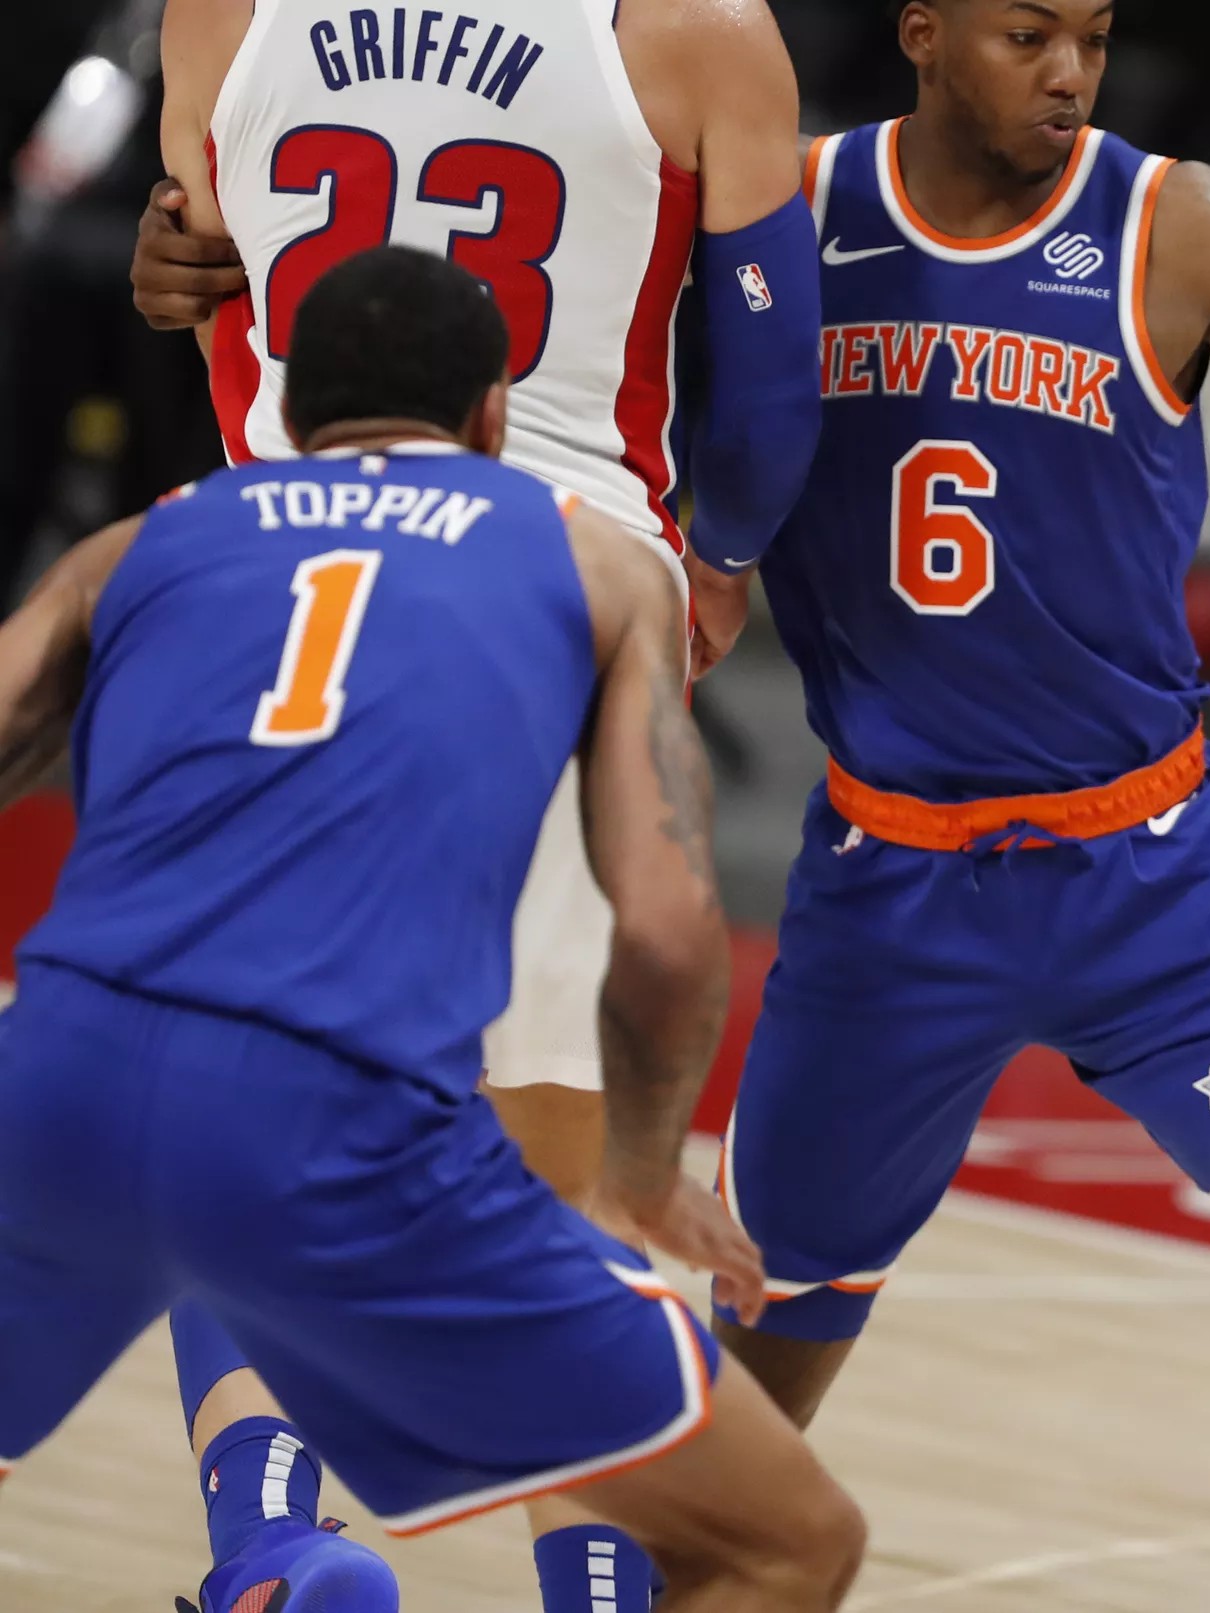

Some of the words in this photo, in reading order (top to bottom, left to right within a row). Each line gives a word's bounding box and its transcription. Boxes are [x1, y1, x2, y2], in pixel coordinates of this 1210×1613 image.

[310, 8, 544, 110] GRIFFIN
[265, 123, 567, 385] 23
[1027, 280, 1111, 299] SQUARESPACE
[946, 322, 1121, 435] YORK
[239, 481, 495, 546] TOPPIN
[890, 439, 997, 616] 6
[249, 548, 382, 747] 1
